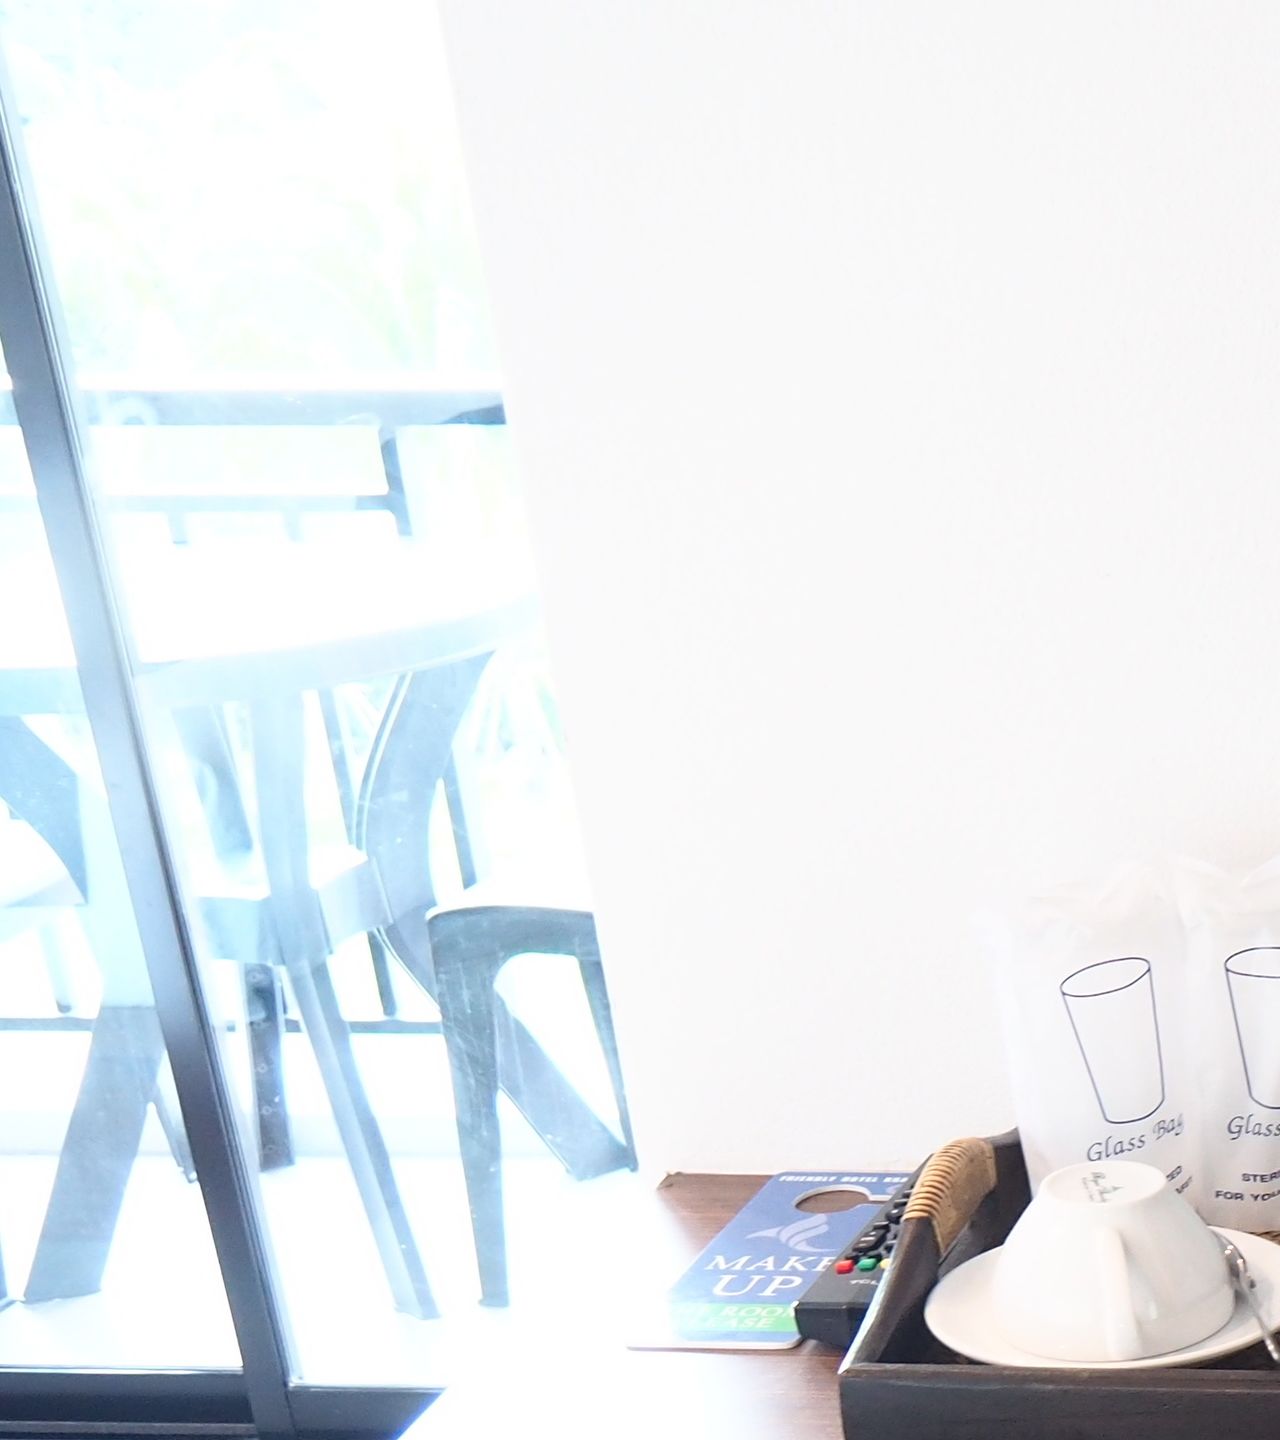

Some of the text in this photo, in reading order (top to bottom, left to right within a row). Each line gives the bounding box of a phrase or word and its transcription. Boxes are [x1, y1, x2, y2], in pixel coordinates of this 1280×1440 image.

[1086, 1113, 1185, 1162] Glass Bag
[1214, 1190, 1245, 1201] FOR
[711, 1274, 802, 1297] UP
